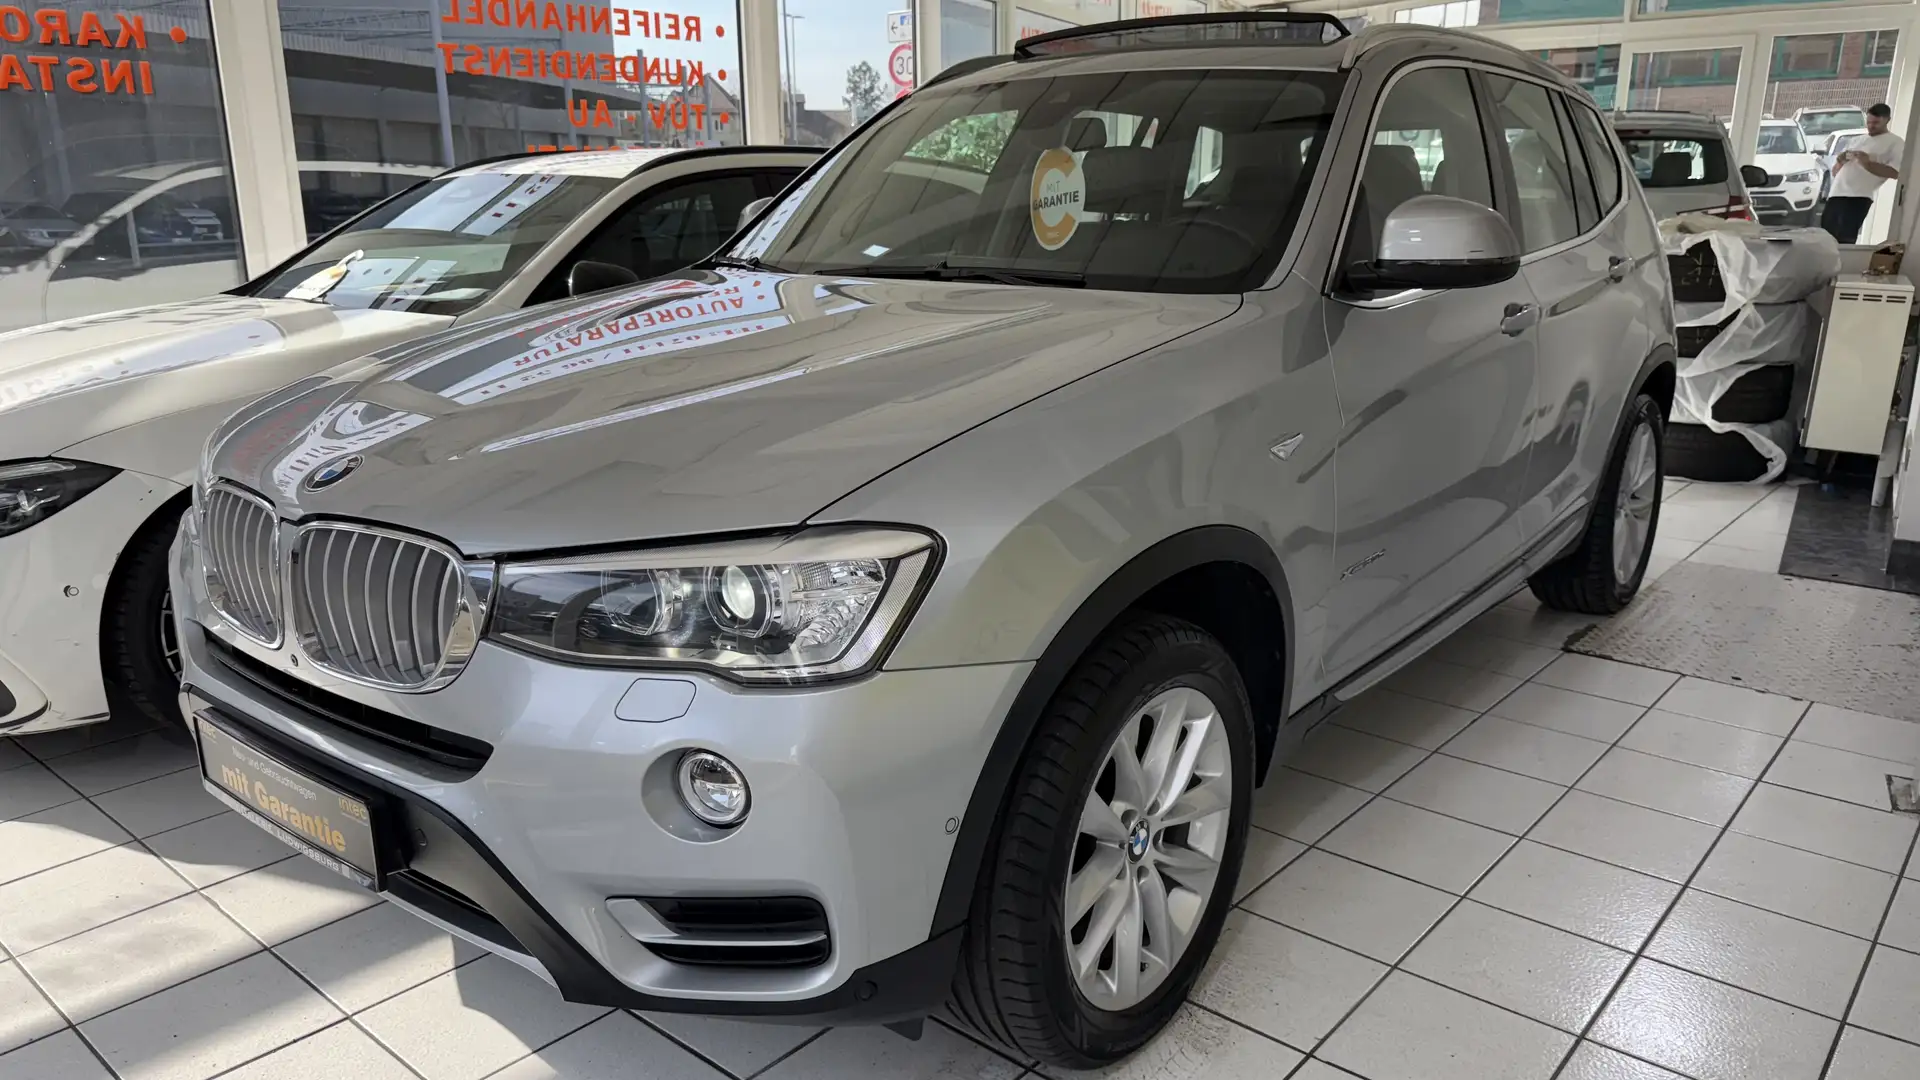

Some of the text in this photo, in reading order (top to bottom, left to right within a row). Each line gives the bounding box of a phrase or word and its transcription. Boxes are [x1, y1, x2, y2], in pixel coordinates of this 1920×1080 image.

[1033, 190, 1080, 211] GARANTIE
[221, 764, 347, 852] mit Garantie
